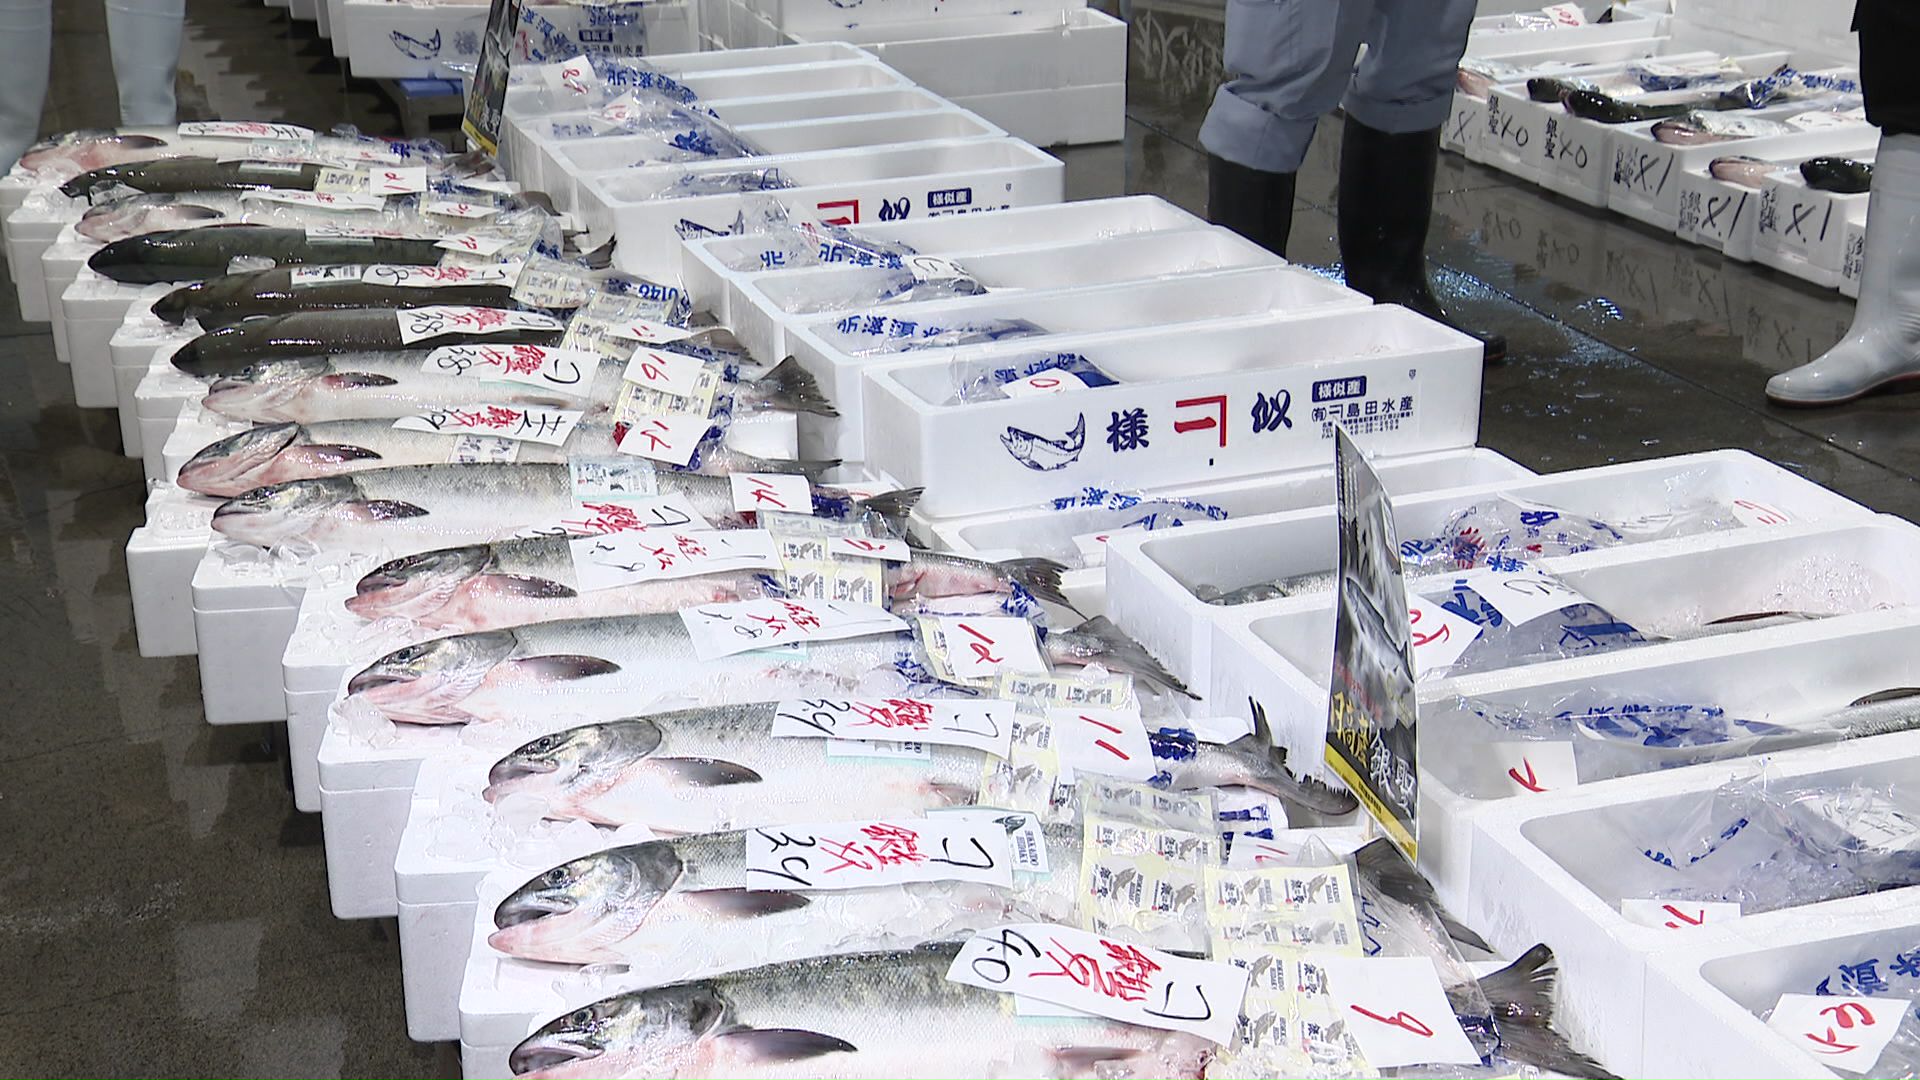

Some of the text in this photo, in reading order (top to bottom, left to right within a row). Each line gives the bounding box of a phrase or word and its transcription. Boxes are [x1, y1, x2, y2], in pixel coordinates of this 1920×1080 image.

[640, 353, 668, 381] 16
[1317, 379, 1362, 400] 様似産
[1106, 408, 1150, 453] 様
[1251, 389, 1295, 434] 似
[746, 476, 787, 509] 14
[1078, 715, 1131, 762] 11
[1369, 717, 1418, 825] 銀聖
